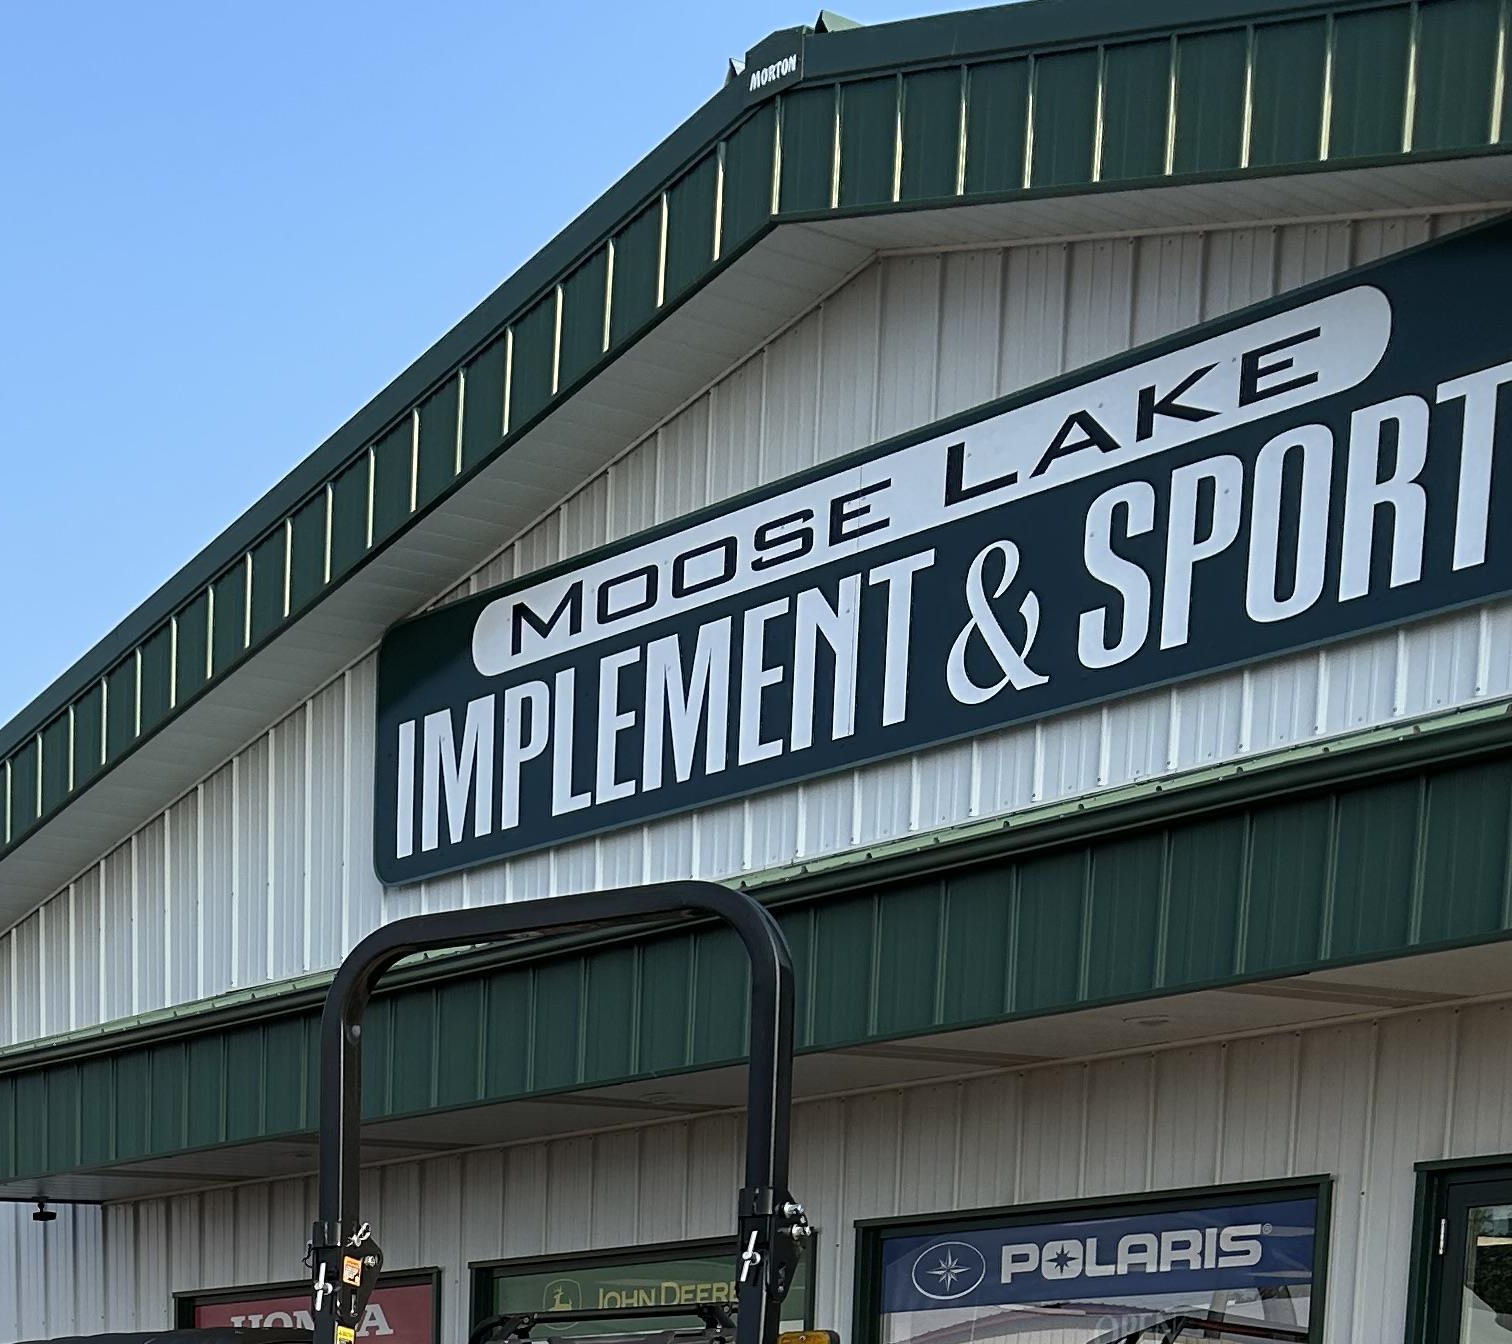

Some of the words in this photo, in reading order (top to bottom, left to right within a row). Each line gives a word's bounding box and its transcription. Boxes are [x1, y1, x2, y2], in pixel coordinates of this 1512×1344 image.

[749, 53, 797, 92] MORTON
[510, 478, 892, 657] MOOSE
[944, 326, 1321, 507] LAKE
[396, 548, 936, 860] IMPLEMENT
[946, 539, 1050, 705] &
[1000, 1223, 1263, 1285] POLARIS
